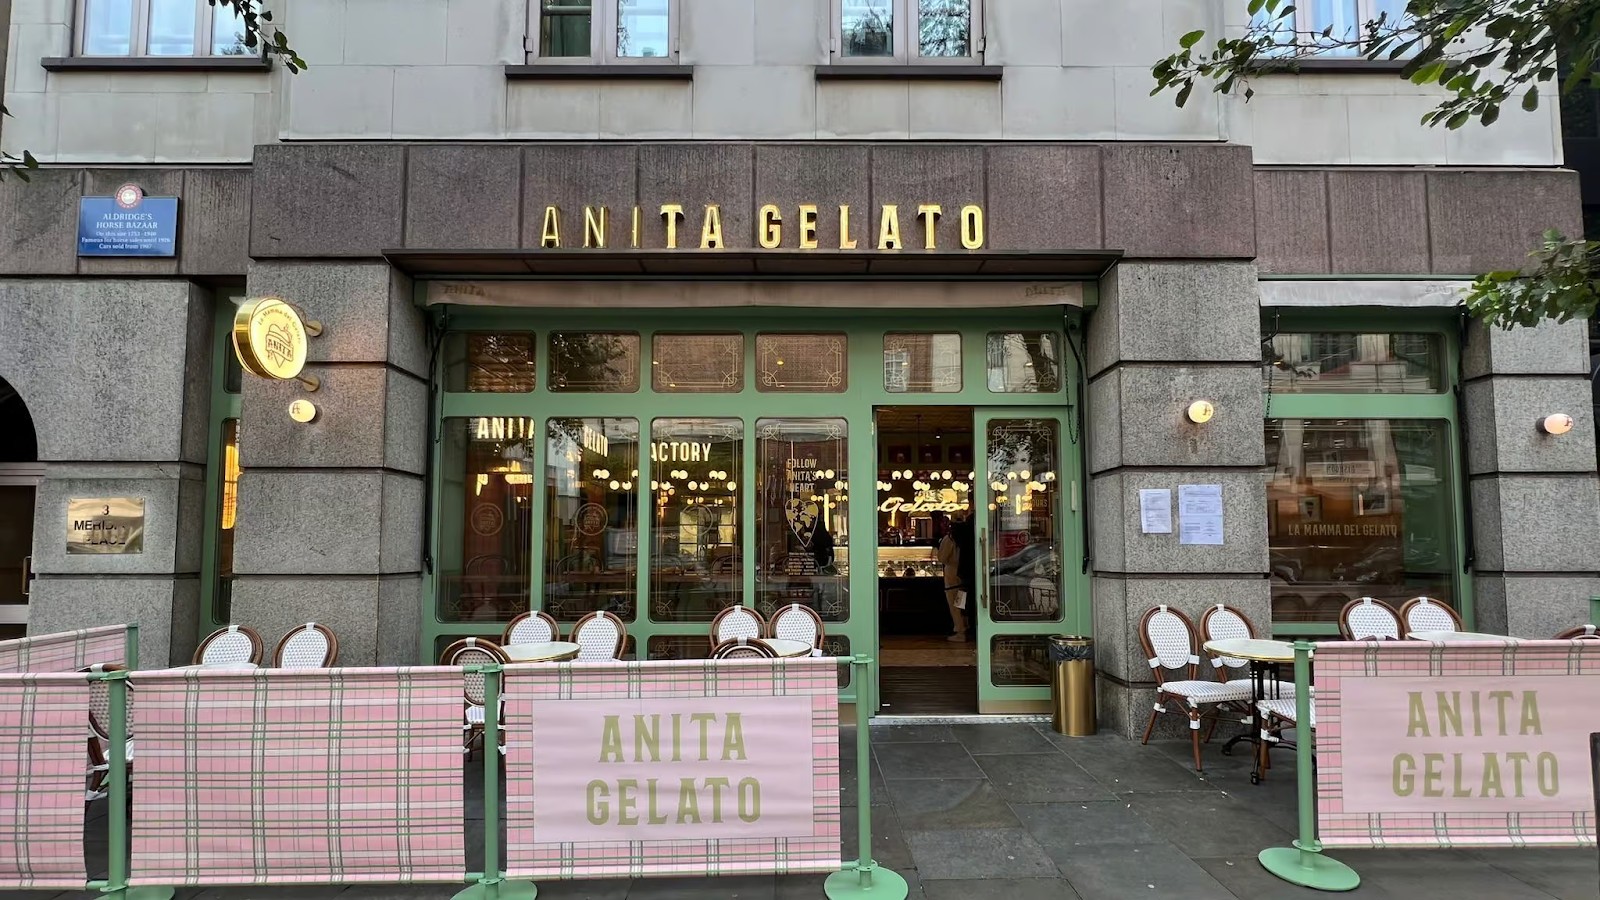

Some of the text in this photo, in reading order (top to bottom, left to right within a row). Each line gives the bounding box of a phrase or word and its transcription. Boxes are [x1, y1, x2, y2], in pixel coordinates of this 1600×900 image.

[96, 221, 158, 229] HORSE BAZAAR
[540, 204, 984, 250] ANITA GELATO
[267, 338, 292, 358] ANITA
[650, 441, 712, 462] ACTORY
[787, 458, 817, 468] FOLLOW
[786, 470, 817, 481] ANITA'S
[102, 504, 110, 515] 3
[1288, 524, 1398, 537] LA MAMMA DEL GELATO
[1406, 690, 1543, 737] ANITA
[598, 712, 748, 762] ANITA
[1392, 751, 1560, 797] GELATO
[586, 776, 761, 826] GELATO
